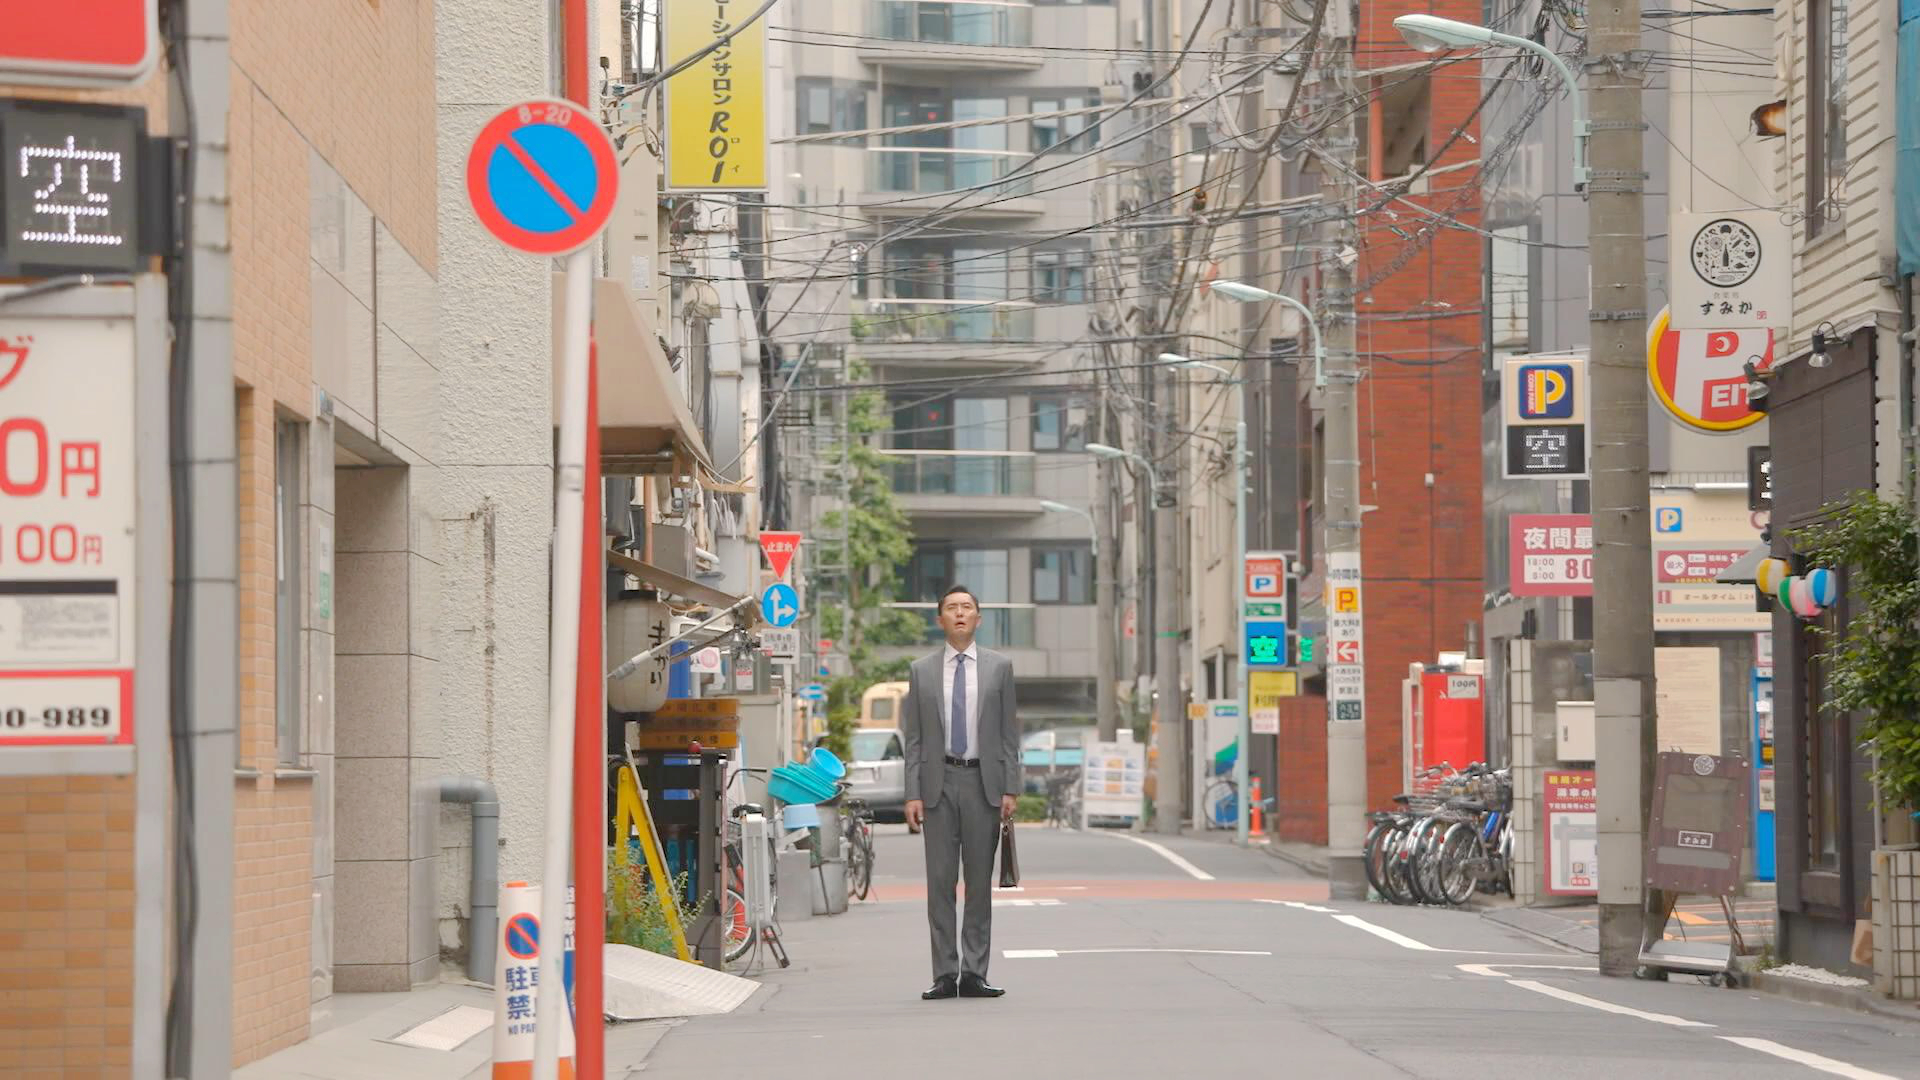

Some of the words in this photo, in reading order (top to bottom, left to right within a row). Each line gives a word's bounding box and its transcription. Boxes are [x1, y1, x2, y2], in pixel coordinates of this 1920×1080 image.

[518, 104, 572, 127] 8-20
[709, 111, 731, 184] ROI
[20, 135, 122, 245] 空
[1700, 300, 1753, 316] すみか
[1525, 429, 1566, 469] 空
[767, 541, 793, 553] 止まれ
[1339, 590, 1354, 611] P
[0, 706, 110, 727] 0-989
[507, 994, 537, 1020] 禁
